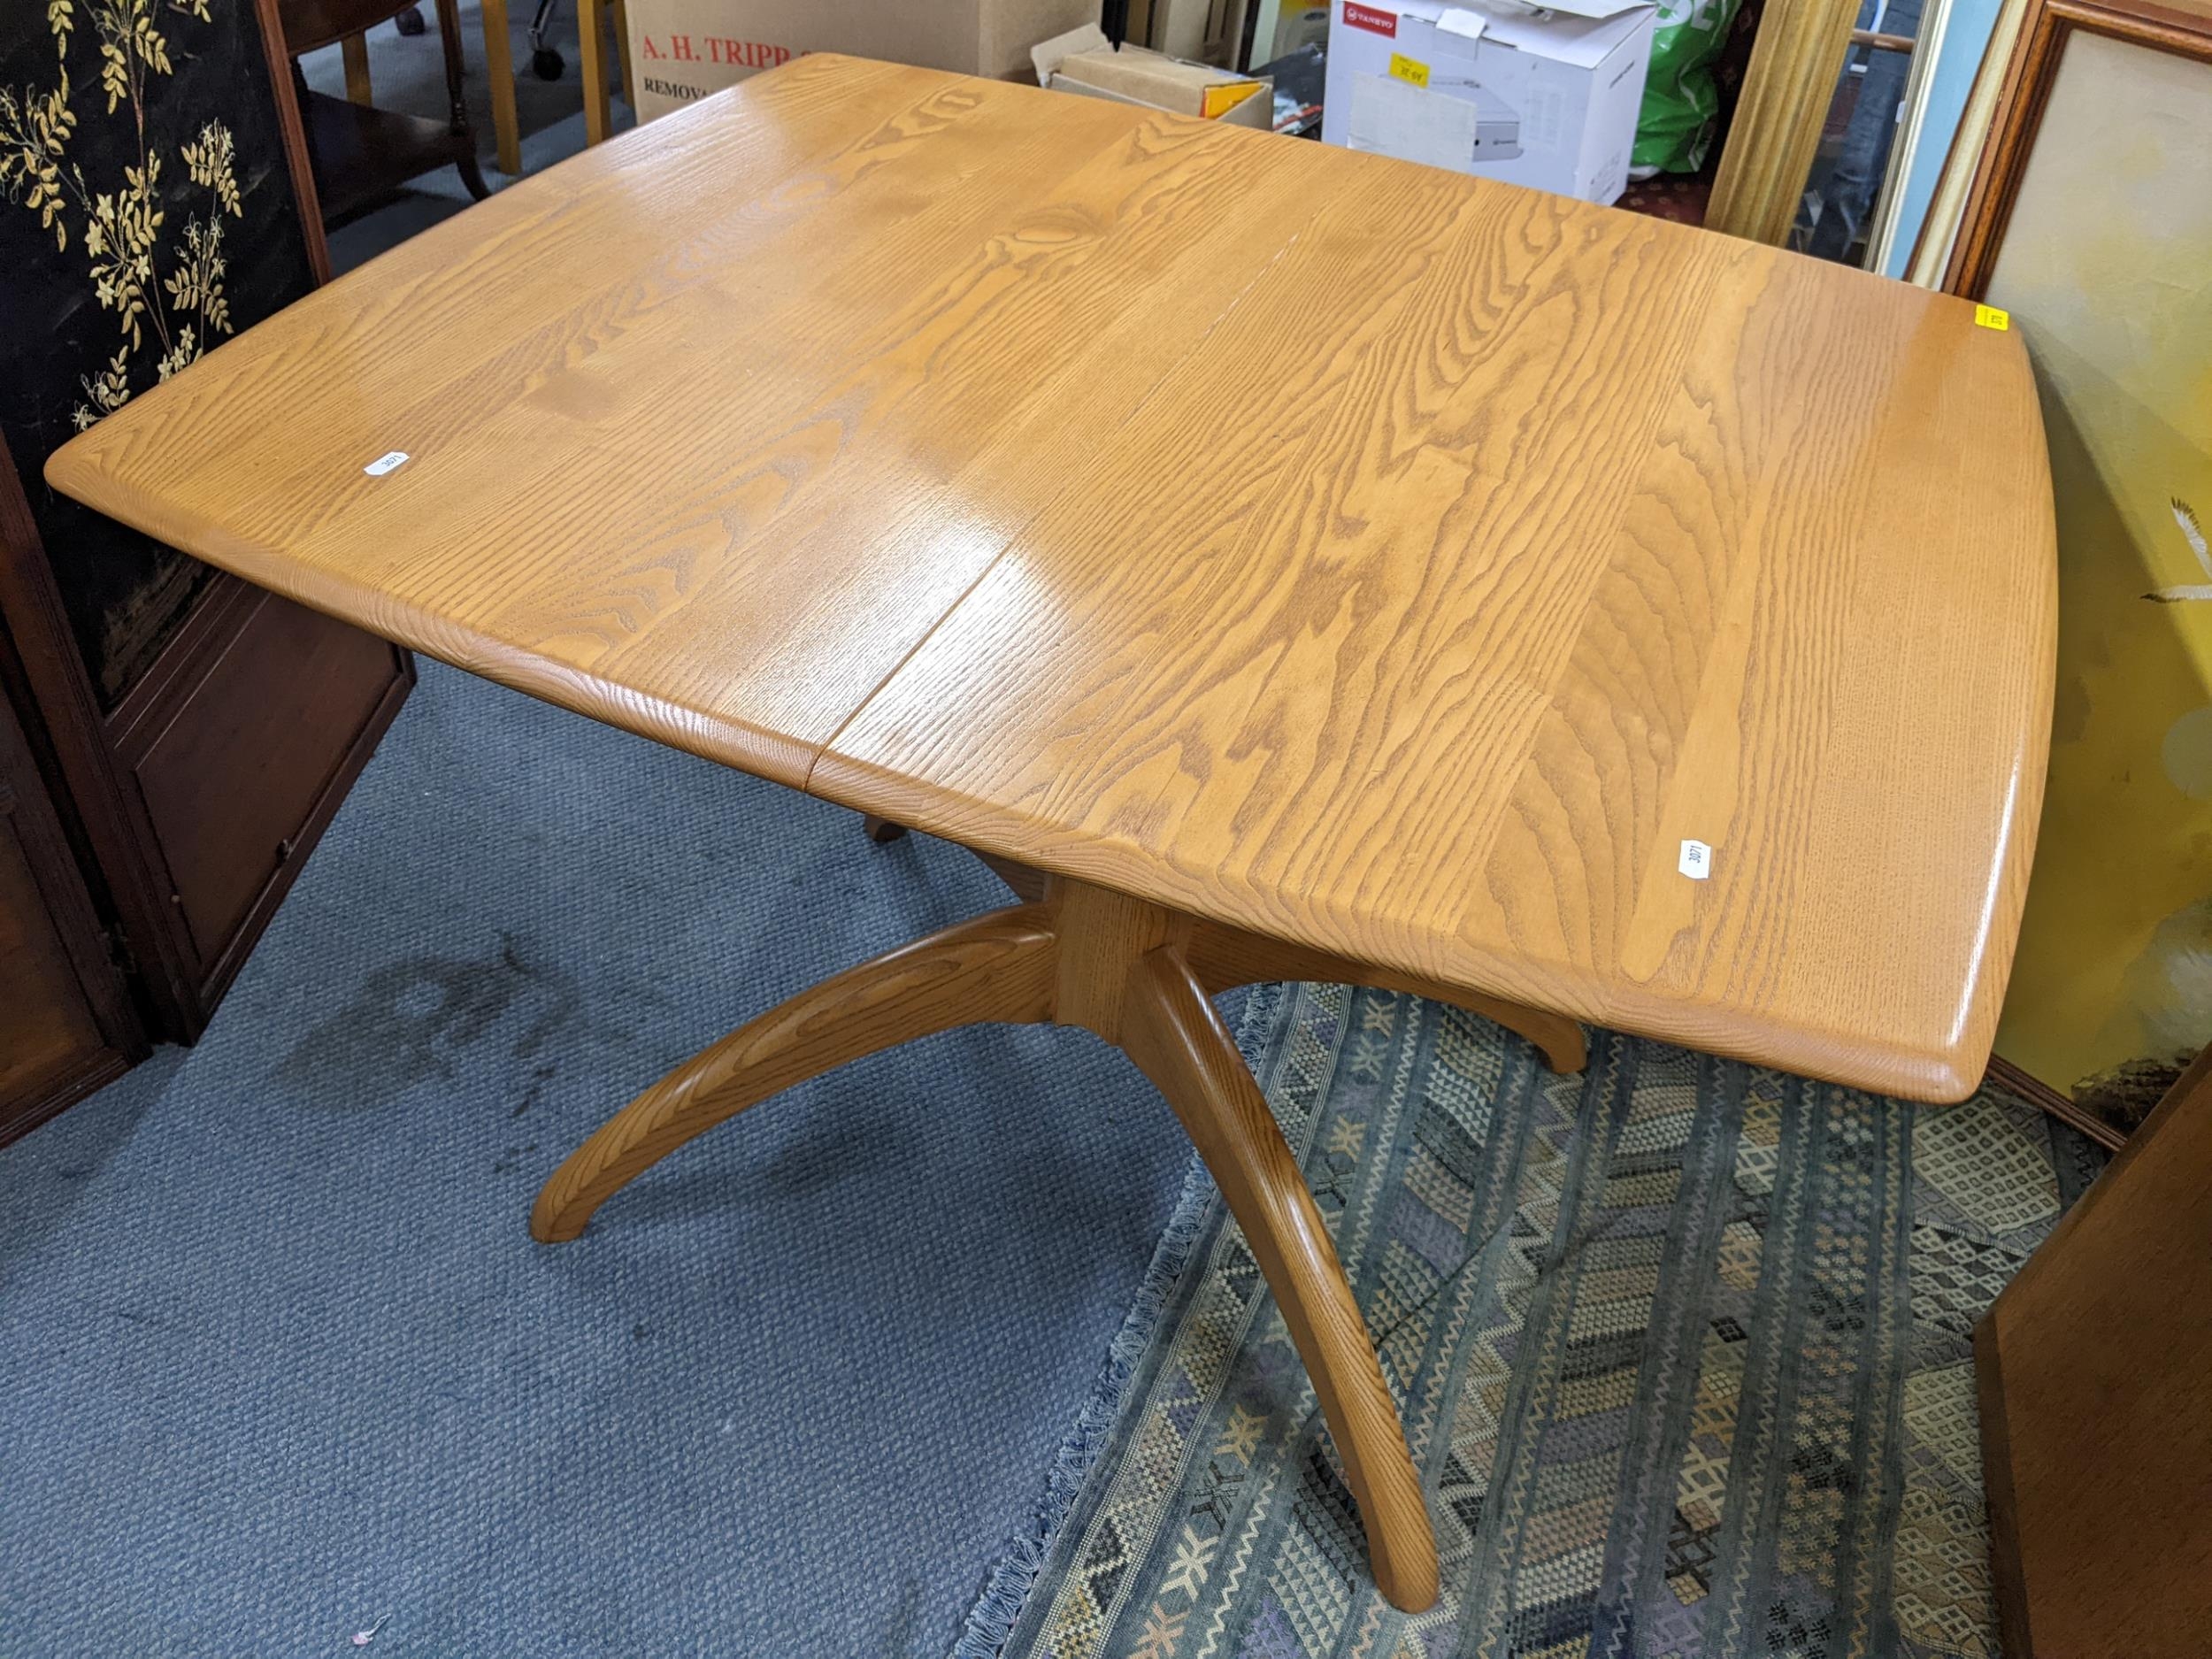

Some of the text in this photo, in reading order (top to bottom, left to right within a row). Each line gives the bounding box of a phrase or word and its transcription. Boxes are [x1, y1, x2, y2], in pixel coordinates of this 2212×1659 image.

[642, 35, 790, 69] A. H. TRIPP
[1688, 845, 1702, 864] 3071
